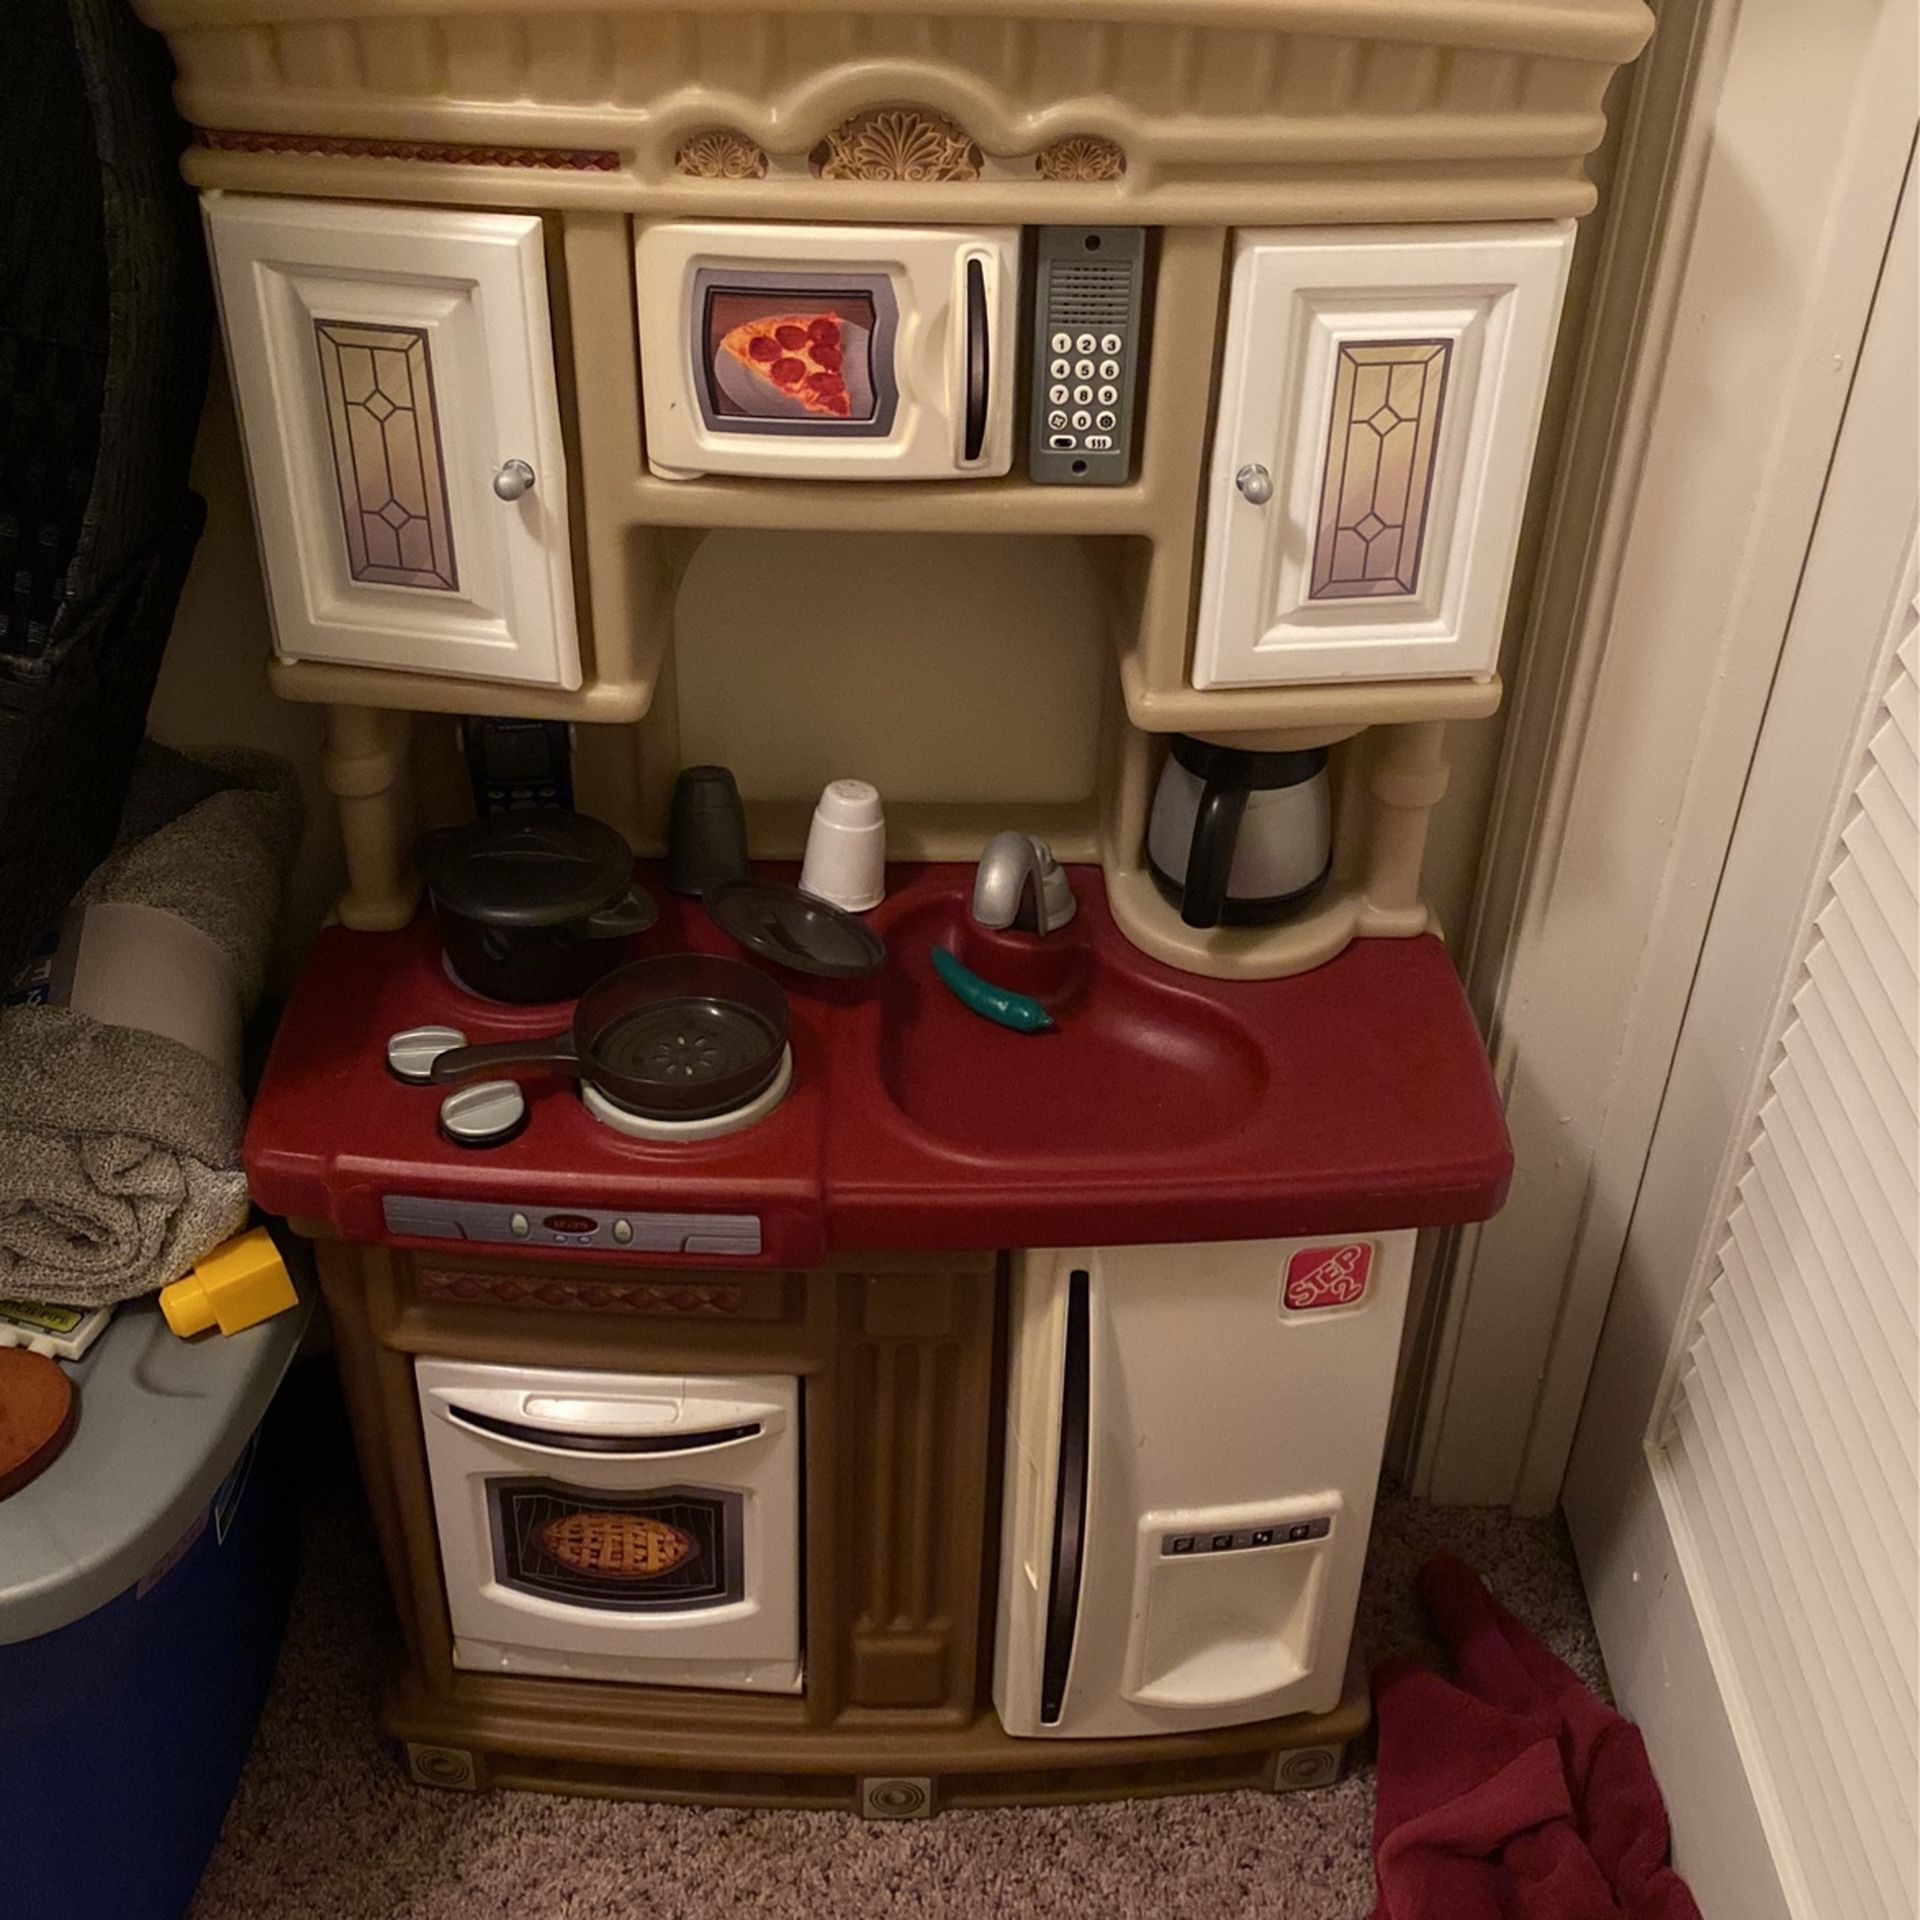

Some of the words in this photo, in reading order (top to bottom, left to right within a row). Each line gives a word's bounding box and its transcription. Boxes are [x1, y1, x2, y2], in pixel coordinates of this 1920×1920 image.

[1082, 340, 1091, 351] 2
[1107, 340, 1116, 351] 3
[1056, 364, 1065, 375] 4
[1081, 365, 1089, 376] 5
[1106, 366, 1114, 377] 6
[1055, 390, 1064, 401] 7
[1079, 390, 1088, 402] 8
[1104, 391, 1112, 401] 9
[1078, 416, 1086, 427] 0
[1288, 1245, 1362, 1307] STEP
[1331, 1276, 1362, 1302] 2
